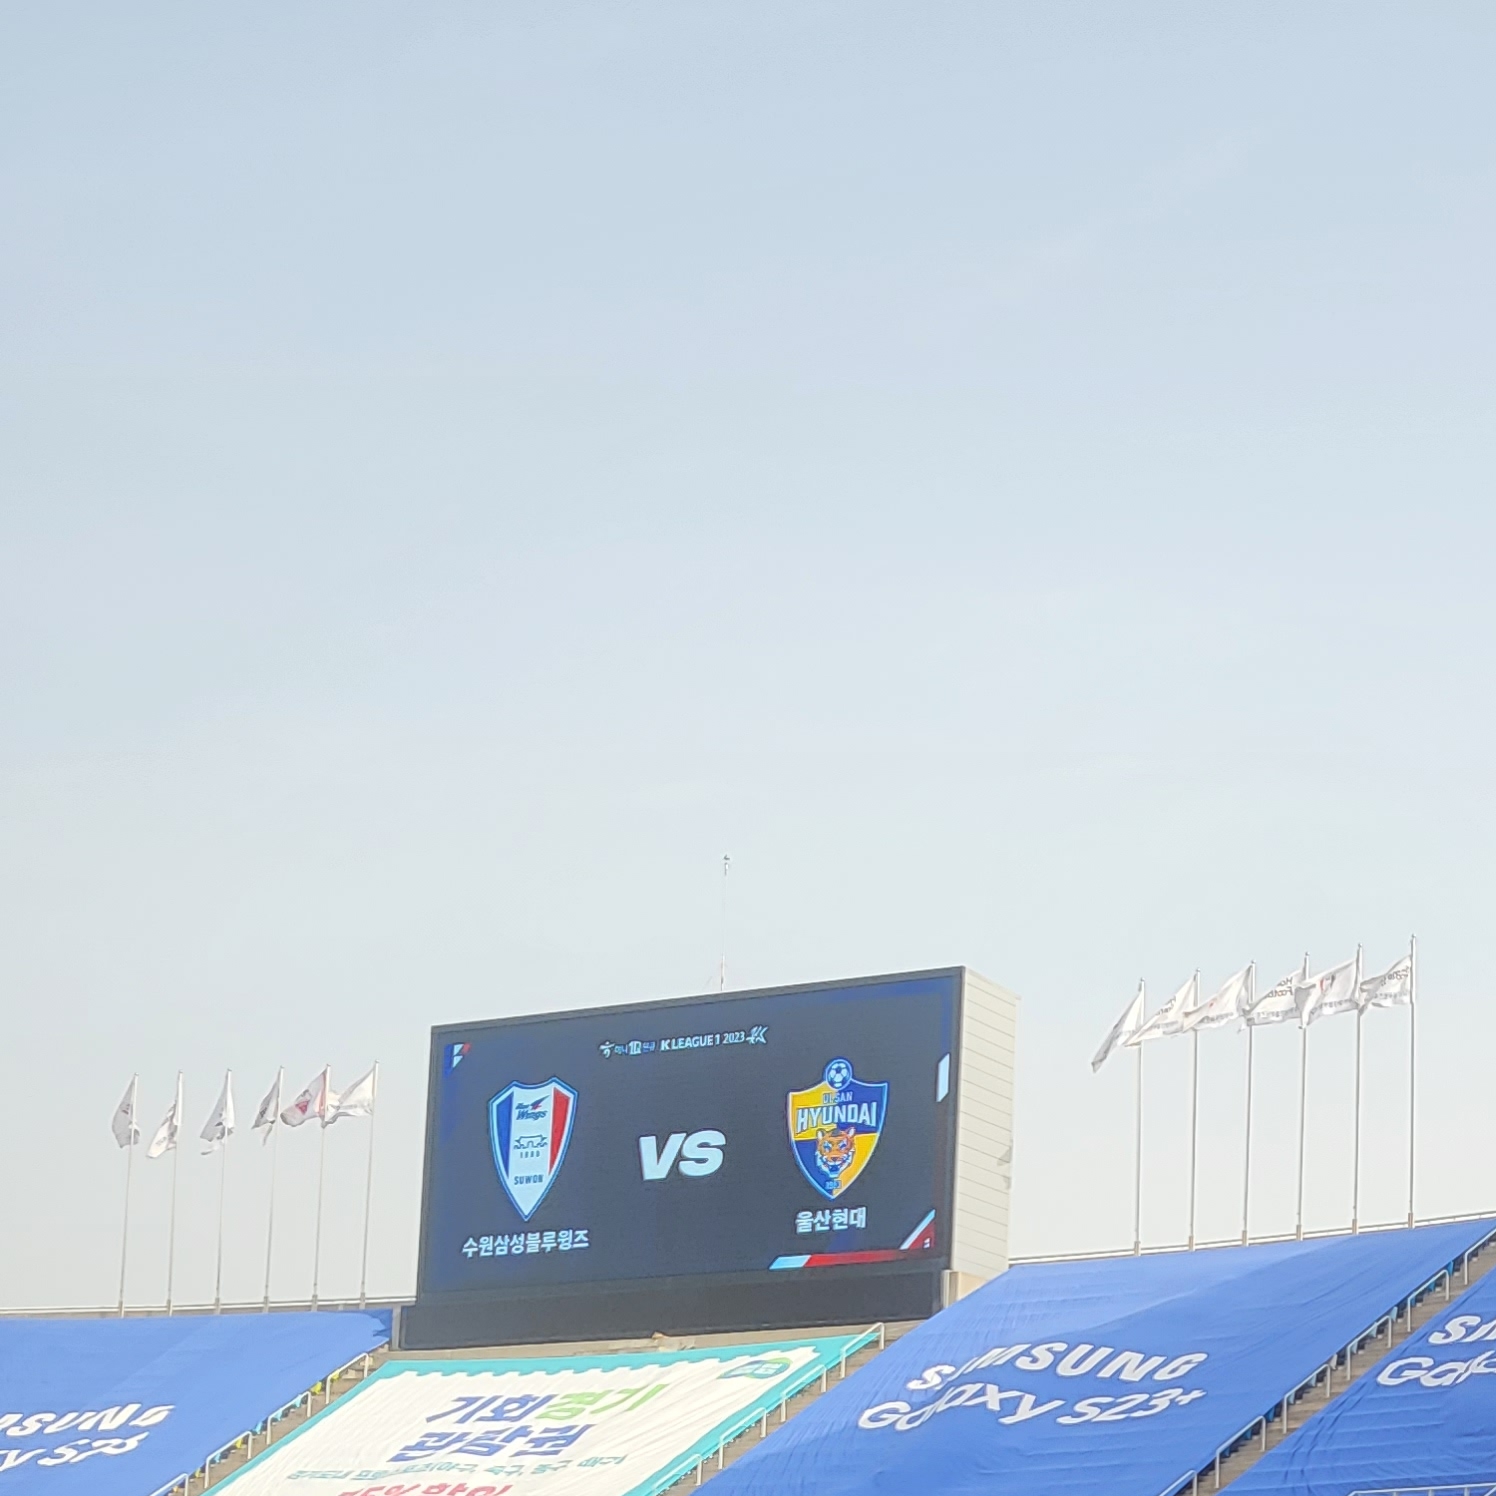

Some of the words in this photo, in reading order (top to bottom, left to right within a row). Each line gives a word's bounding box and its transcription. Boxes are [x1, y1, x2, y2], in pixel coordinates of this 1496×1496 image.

[671, 1034, 713, 1050] LEAGUE
[722, 1031, 746, 1044] 2023
[796, 1101, 878, 1134] HYUNDAI
[638, 1129, 727, 1182] VS
[795, 1207, 867, 1234] 울산현대
[461, 1229, 590, 1259] 수원삼성블루윙즈
